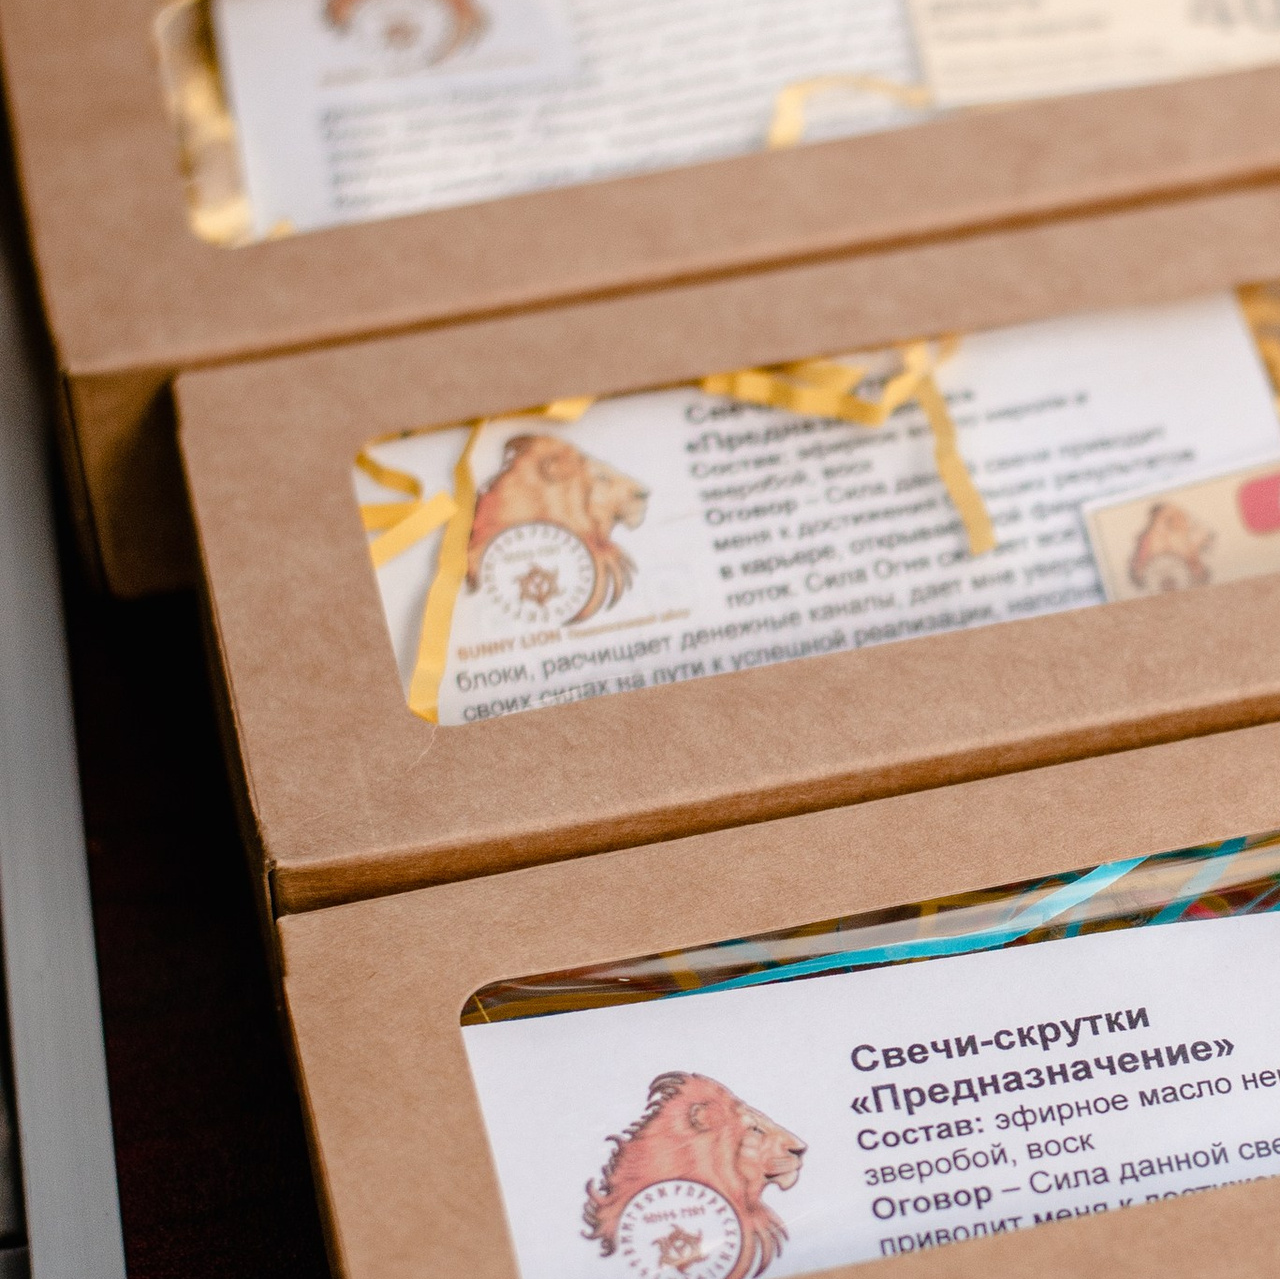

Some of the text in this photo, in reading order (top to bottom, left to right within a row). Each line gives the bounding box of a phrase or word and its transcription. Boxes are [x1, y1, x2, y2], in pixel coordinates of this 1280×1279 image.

[454, 657, 537, 695] блоки,
[541, 633, 672, 679] расчищает
[850, 1006, 1150, 1073] Свечи-скрутки
[849, 1037, 1235, 1116] «Предназначение»
[856, 1116, 985, 1151] Состав:
[995, 1090, 1130, 1133] эфирное
[1139, 1076, 1232, 1108] масло
[864, 1131, 1095, 1187] зверобой, воск
[872, 1184, 993, 1222] Оговор
[1029, 1164, 1110, 1196] Сила
[1119, 1142, 1230, 1185] данной
